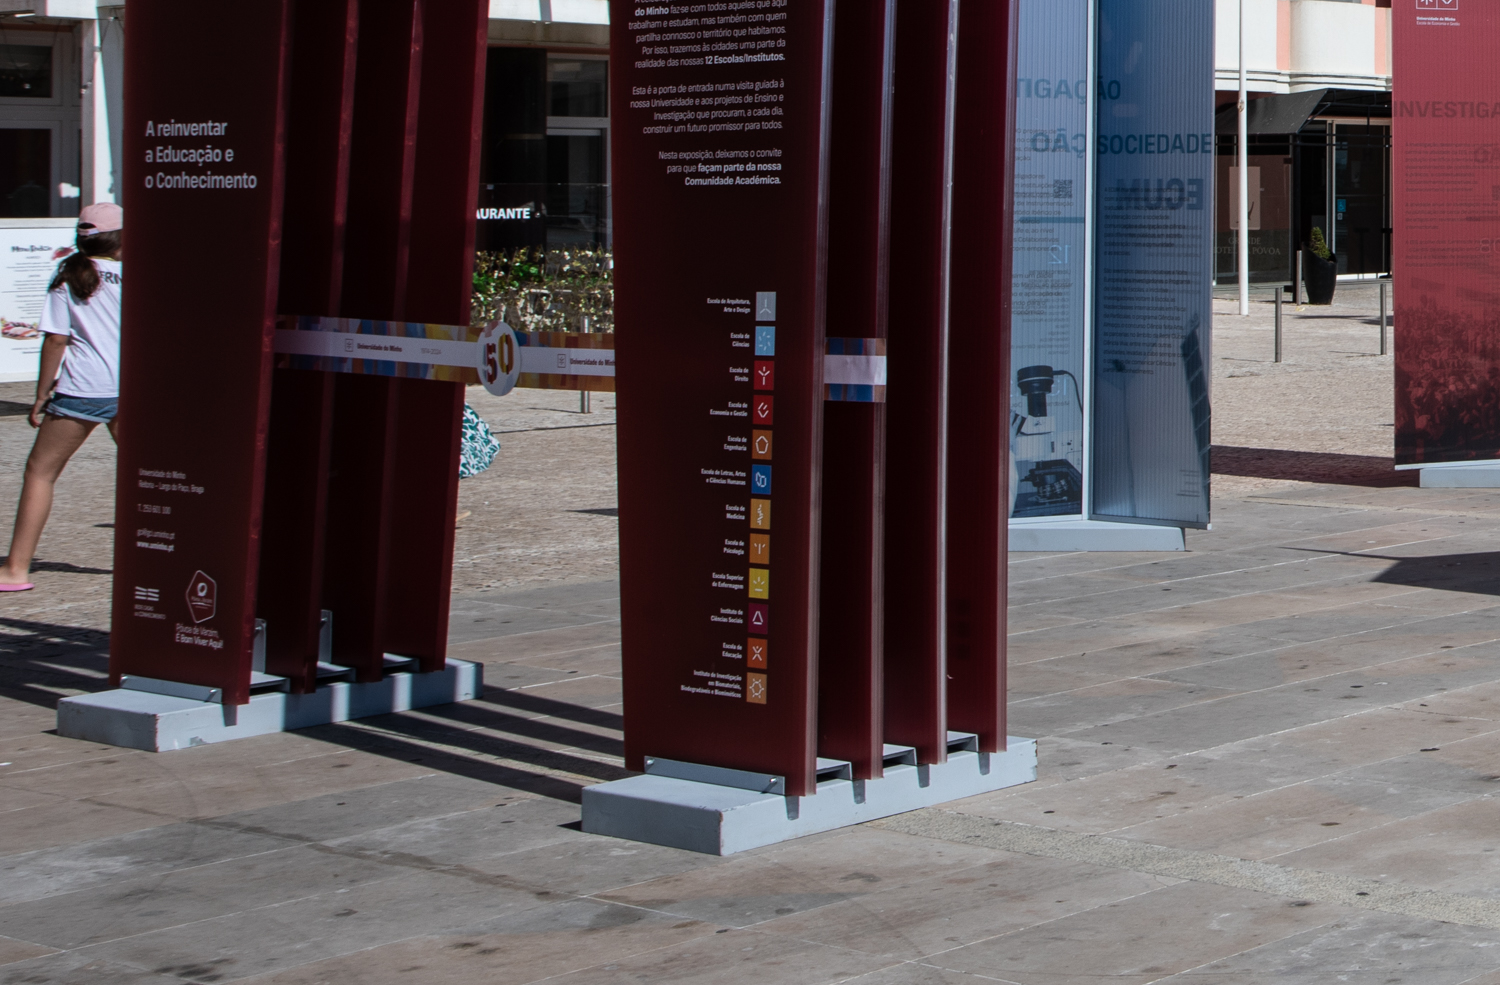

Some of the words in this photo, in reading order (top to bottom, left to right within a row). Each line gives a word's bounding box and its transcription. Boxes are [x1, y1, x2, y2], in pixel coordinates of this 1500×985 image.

[635, 8, 645, 16] do
[647, 6, 669, 15] Minho
[671, 5, 688, 13] faz-se
[708, 2, 726, 11] todos
[728, 0, 755, 11] aqueles
[757, 0, 770, 9] que
[629, 20, 661, 29] trabalham
[717, 14, 746, 24] também
[766, 13, 787, 22] quem
[636, 33, 660, 44] partilha
[662, 33, 695, 41] connosco
[703, 29, 731, 38] território
[733, 29, 746, 38] que
[643, 46, 652, 54] Por
[670, 45, 700, 53] trazemos
[703, 43, 710, 51] às
[712, 42, 738, 50] cidades
[757, 40, 775, 50] parte
[777, 39, 785, 47] da
[635, 58, 665, 68] realidade
[667, 58, 679, 66] das
[705, 56, 713, 64] 12
[633, 87, 646, 95] Esta
[659, 85, 676, 95] porta
[678, 84, 686, 92] de
[688, 83, 713, 92] entrada
[737, 81, 753, 89] visita
[755, 80, 778, 90] guiada
[651, 97, 693, 106] Universidade
[715, 95, 742, 105] projetos
[744, 94, 753, 102] de
[755, 94, 777, 102] Ensino
[654, 110, 695, 121] Investigação
[697, 111, 709, 120] que
[753, 107, 770, 116] cada
[145, 121, 155, 136] A
[157, 119, 228, 136] reinventar
[643, 124, 672, 133] construir
[687, 124, 707, 132] futuro
[709, 122, 743, 133] promissor
[745, 123, 760, 131] para
[1097, 133, 1212, 155] SOCIEDADE
[145, 149, 153, 162] a
[156, 145, 222, 167] Educação
[225, 149, 234, 162] e
[659, 151, 677, 159] Nesta
[715, 150, 748, 158] deixamos
[756, 148, 782, 157] convite
[667, 166, 682, 174] para
[683, 165, 696, 174] que
[698, 164, 722, 173] façam
[724, 163, 744, 173] parte
[746, 163, 755, 171] da
[145, 176, 154, 188] o
[156, 171, 257, 188] Conhecimento
[685, 176, 733, 185] Comunidade
